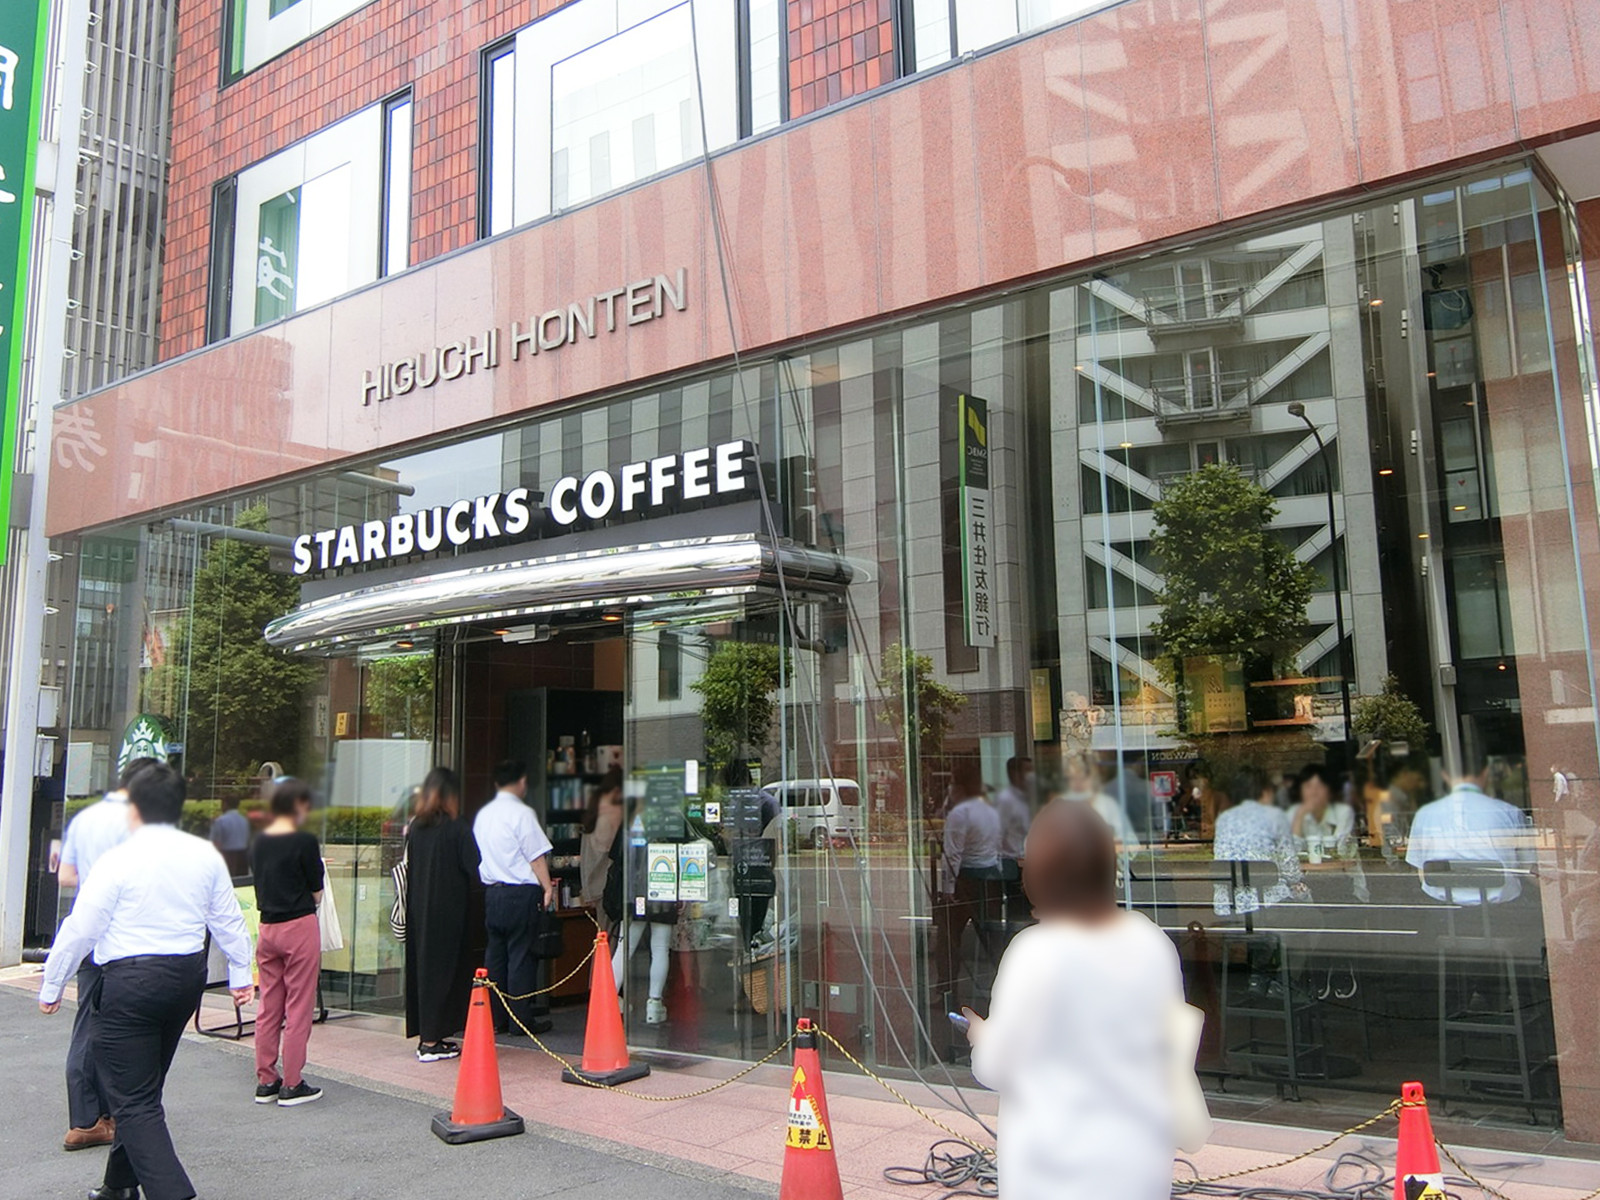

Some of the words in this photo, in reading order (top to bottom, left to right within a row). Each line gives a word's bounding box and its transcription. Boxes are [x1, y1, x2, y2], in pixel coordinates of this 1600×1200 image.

[361, 327, 499, 406] HIGUCHI
[511, 267, 687, 361] HONTEN
[292, 488, 532, 575] STARBUCKS
[550, 440, 748, 526] COFFEE
